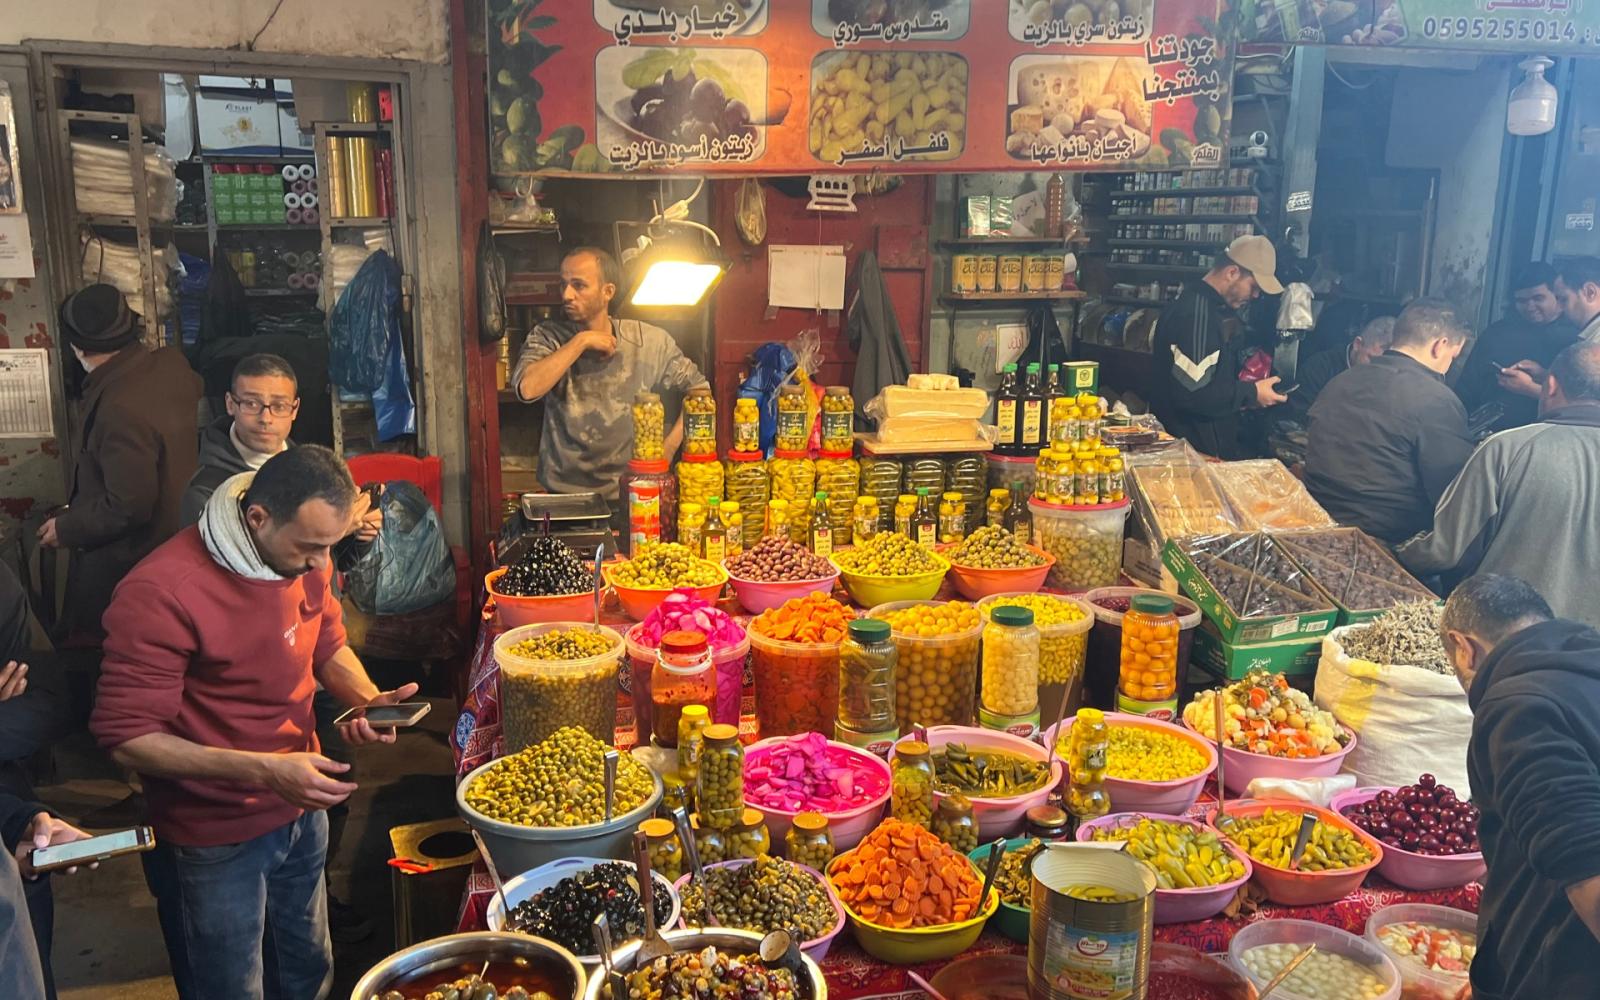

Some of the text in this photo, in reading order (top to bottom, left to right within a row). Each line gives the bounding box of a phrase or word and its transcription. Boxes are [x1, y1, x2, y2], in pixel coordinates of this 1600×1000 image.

[614, 4, 738, 46] خيار بلدي
[833, 13, 949, 47] مقدوس سوري
[1023, 16, 1145, 46] زيتون سري بالزيت
[1423, 17, 1576, 41] 0595255014
[1146, 36, 1215, 65] جودتنا
[1143, 69, 1219, 105] بمنتجنا
[670, 134, 708, 161] أسود
[711, 134, 753, 161] زيتون
[835, 132, 949, 166] فلفل أصفر
[1032, 134, 1137, 164] أجبان بأنواعها
